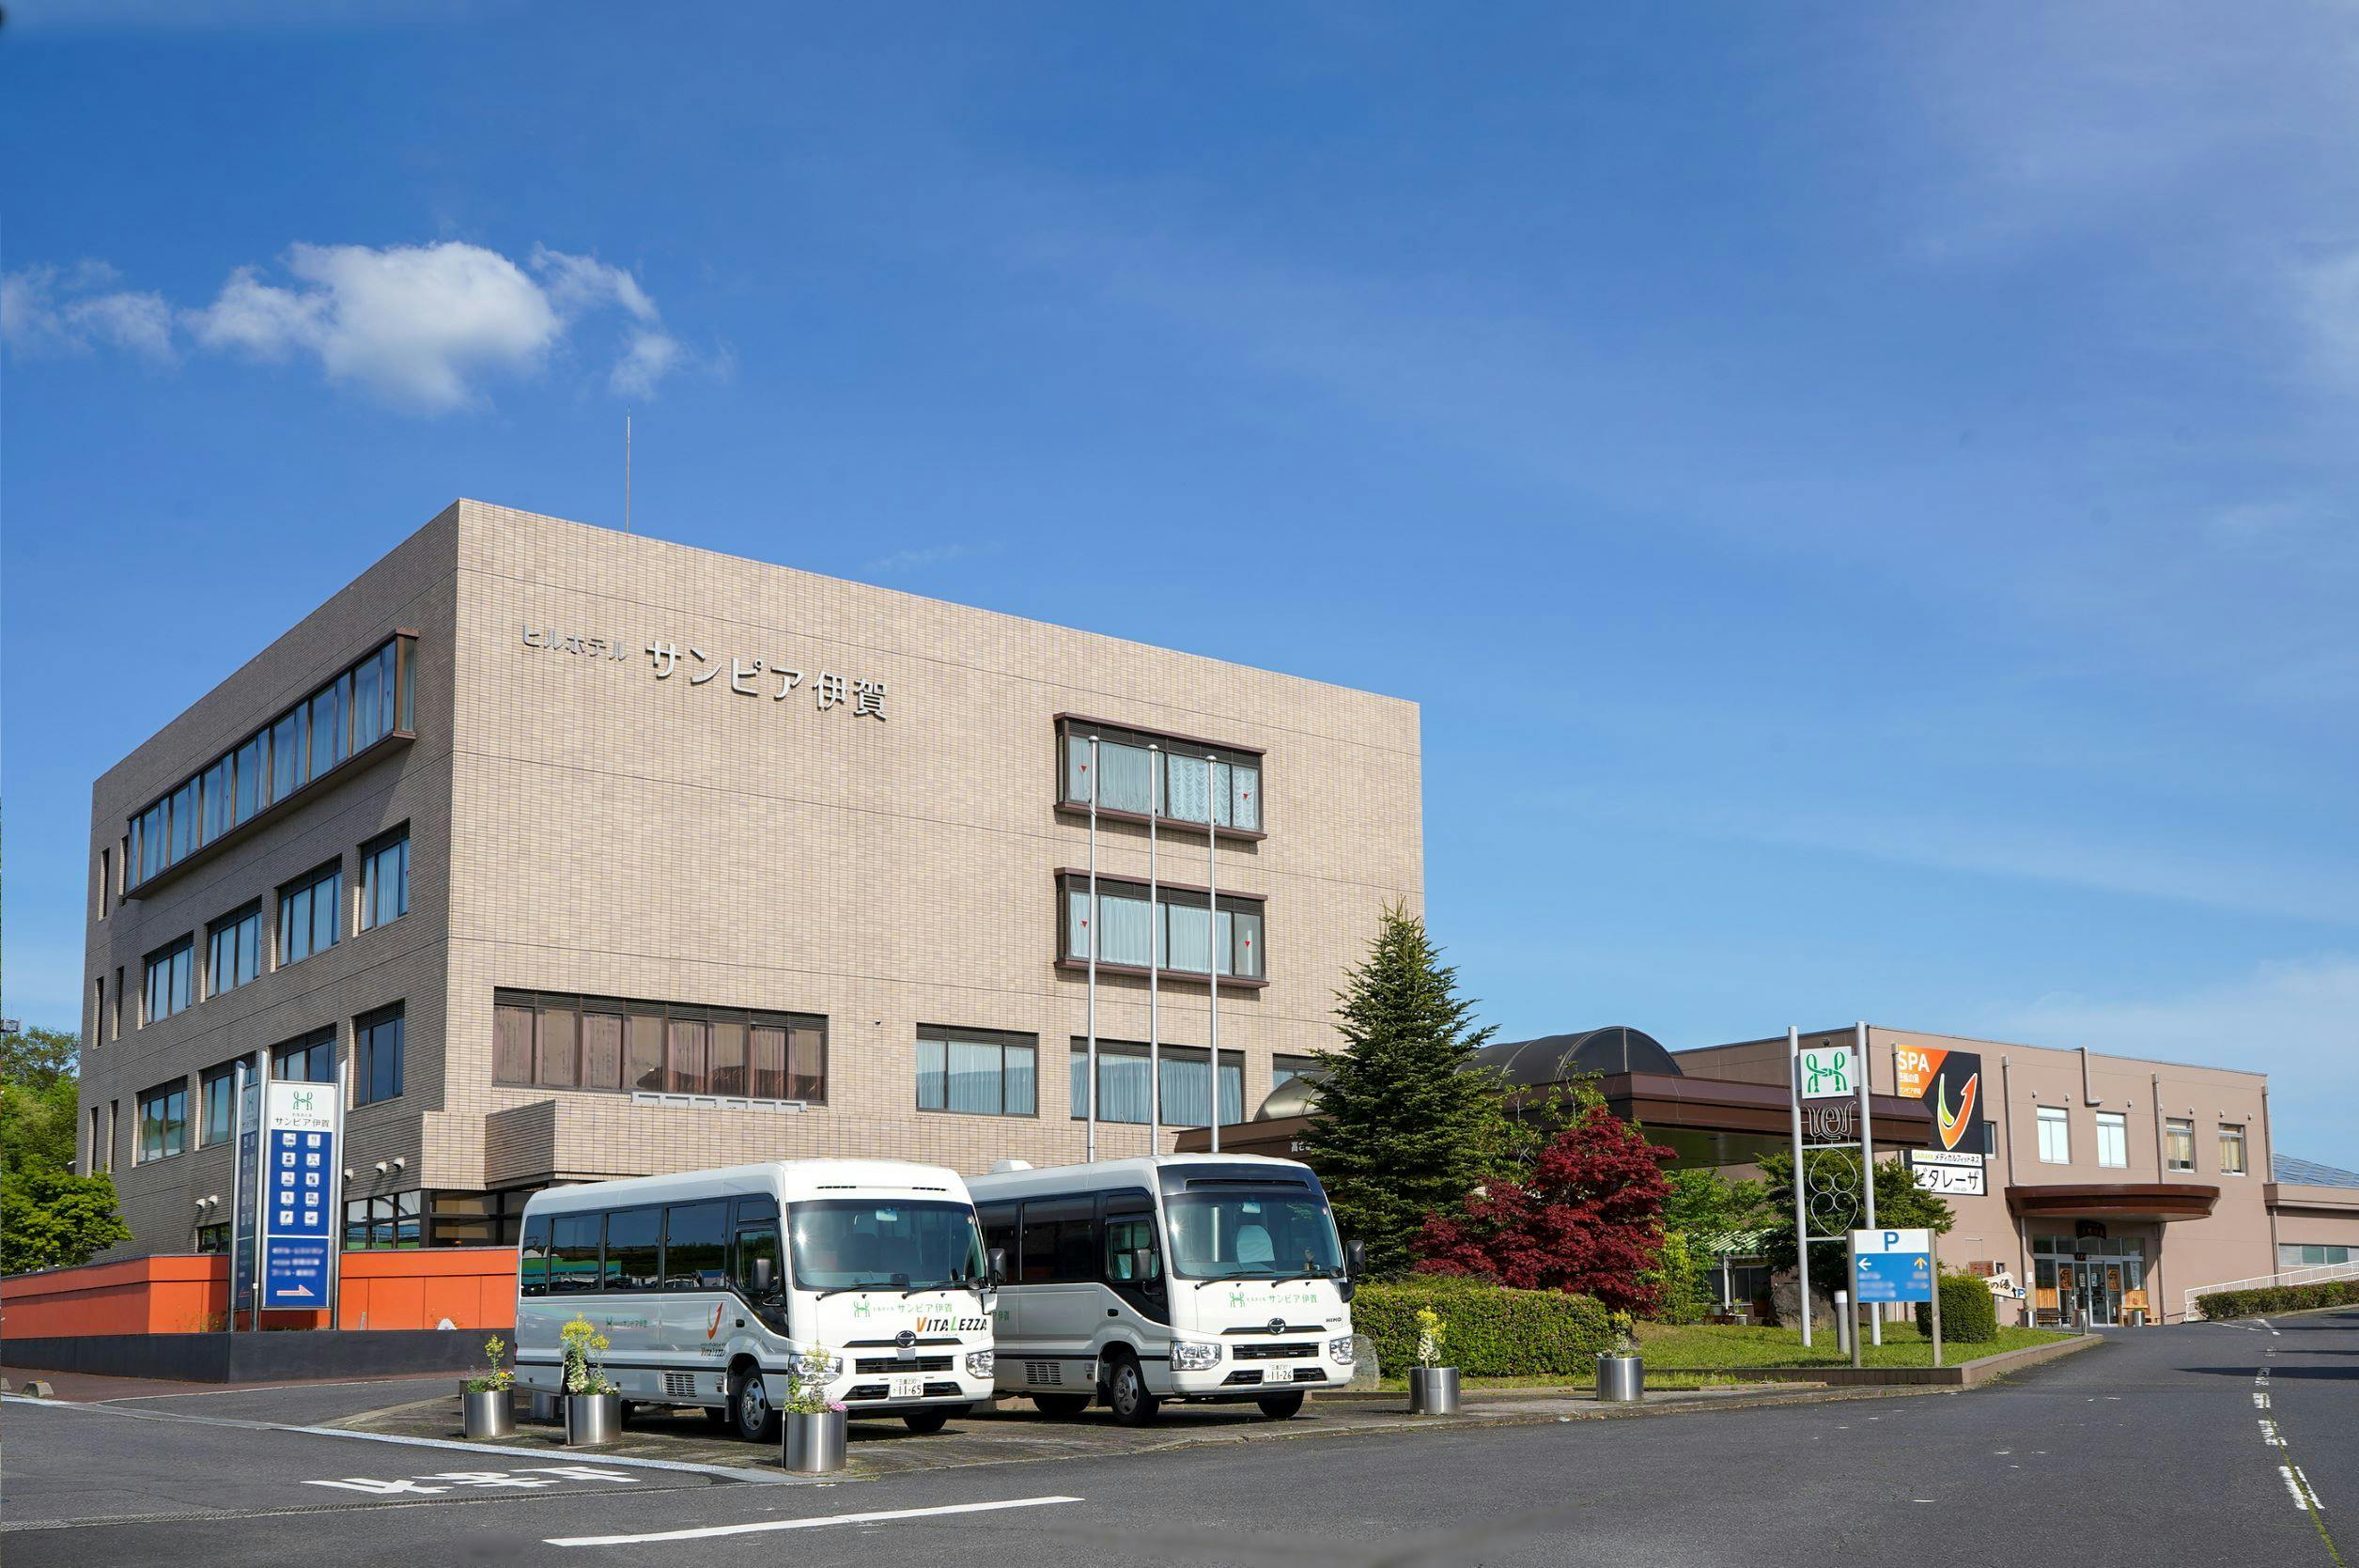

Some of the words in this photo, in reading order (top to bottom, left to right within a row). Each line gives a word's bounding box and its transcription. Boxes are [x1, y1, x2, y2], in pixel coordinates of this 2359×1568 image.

[522, 624, 629, 661] ヒルホテル
[644, 640, 888, 722] サンピア伊賀
[1896, 1050, 1931, 1073] SPA
[1914, 1167, 1979, 1190] ビタレーザ
[1884, 1231, 1900, 1252] P
[2016, 1288, 2026, 1299] P
[916, 1316, 987, 1332] VITALEZZA
[898, 1385, 922, 1395] 11-65
[299, 1466, 642, 1495] 止まれ
